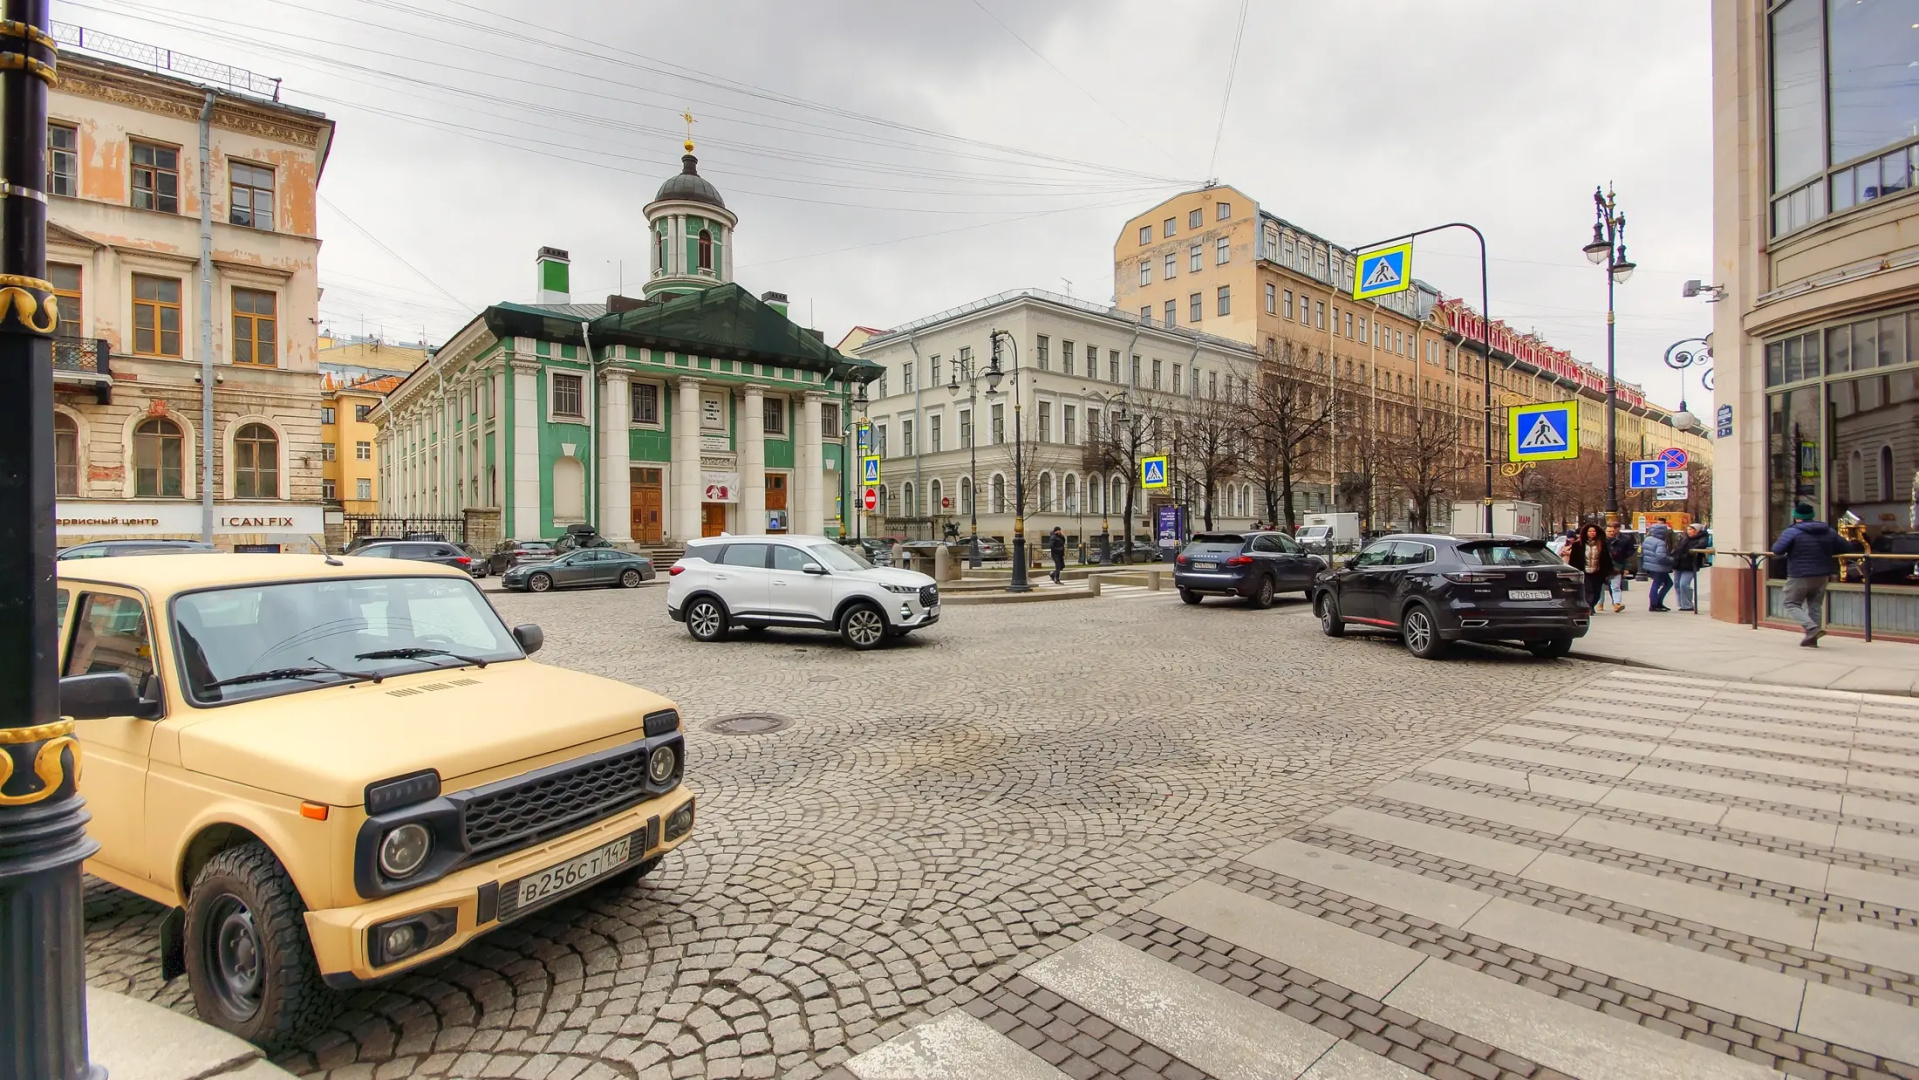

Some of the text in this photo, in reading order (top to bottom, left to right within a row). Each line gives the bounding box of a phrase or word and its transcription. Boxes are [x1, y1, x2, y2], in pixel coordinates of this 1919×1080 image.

[1640, 463, 1660, 486] P
[56, 517, 159, 526] ервисный центр
[229, 517, 264, 527] CAN
[268, 517, 294, 527] FIX
[604, 841, 628, 862] 147
